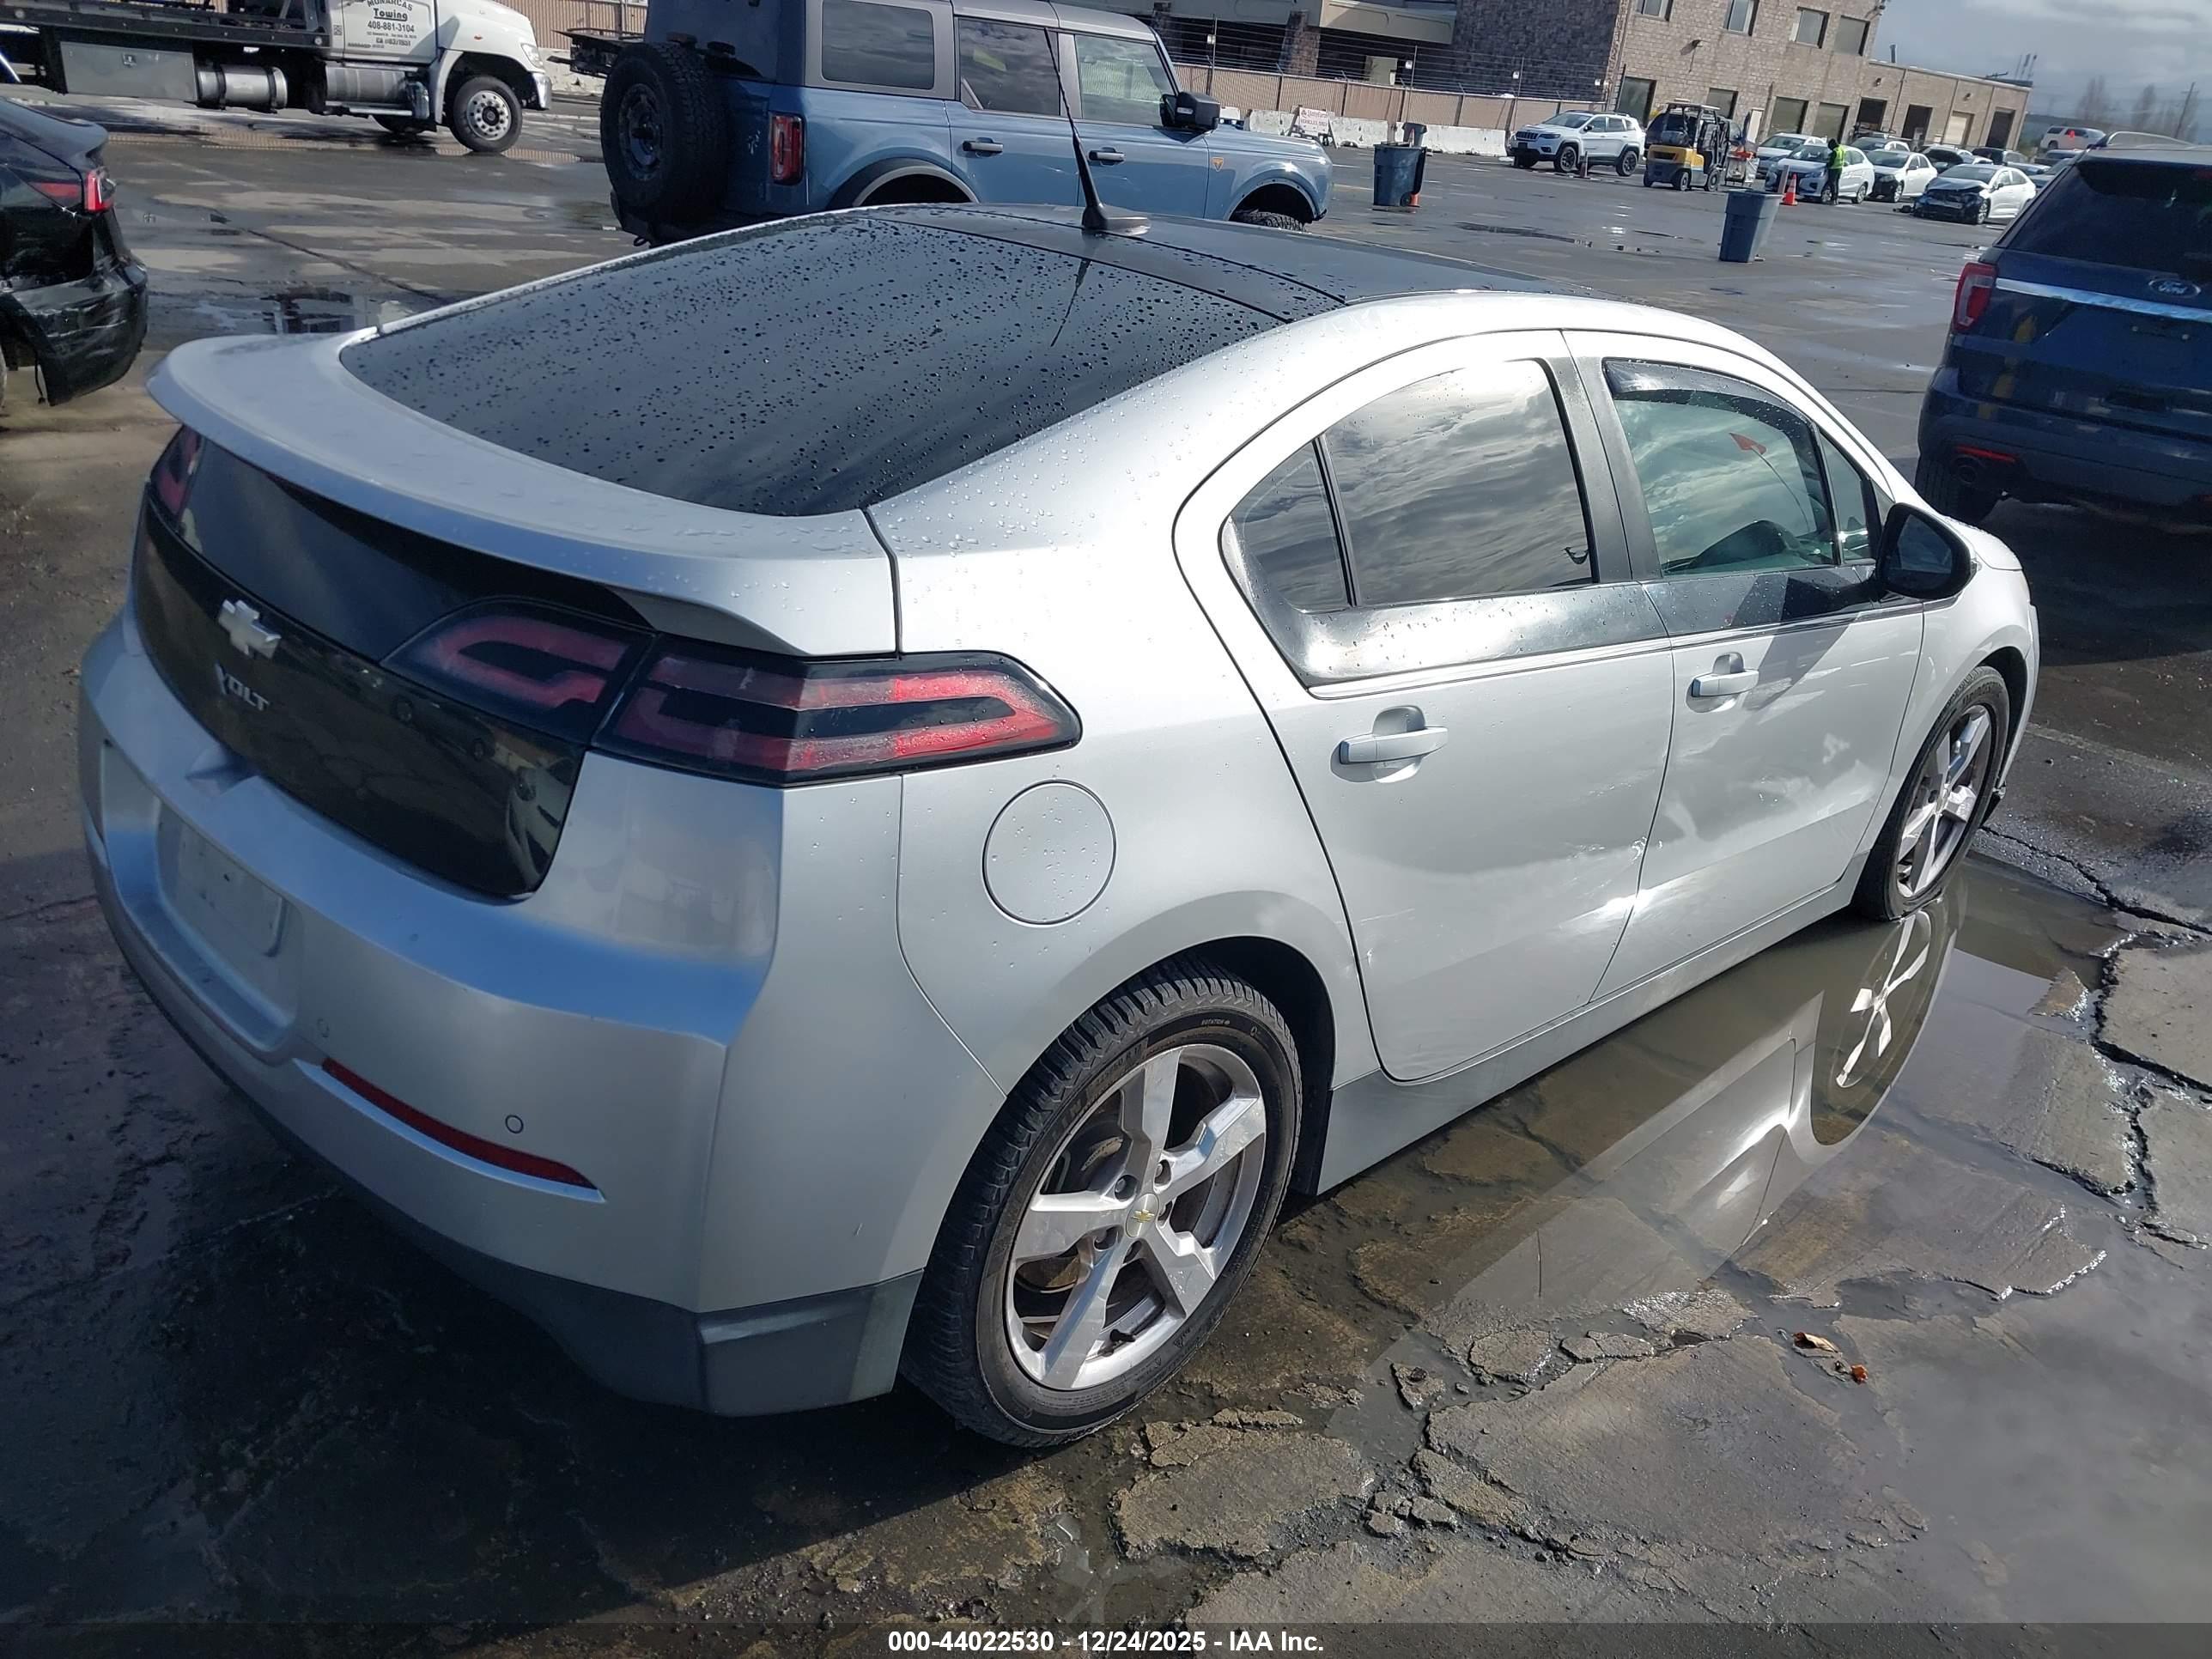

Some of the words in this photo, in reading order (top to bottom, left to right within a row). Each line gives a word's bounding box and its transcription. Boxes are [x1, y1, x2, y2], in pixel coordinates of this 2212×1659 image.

[373, 8, 408, 21] Towing
[368, 21, 415, 32] 408-881-3104
[2158, 280, 2188, 295] Ford
[214, 660, 270, 711] VOLT
